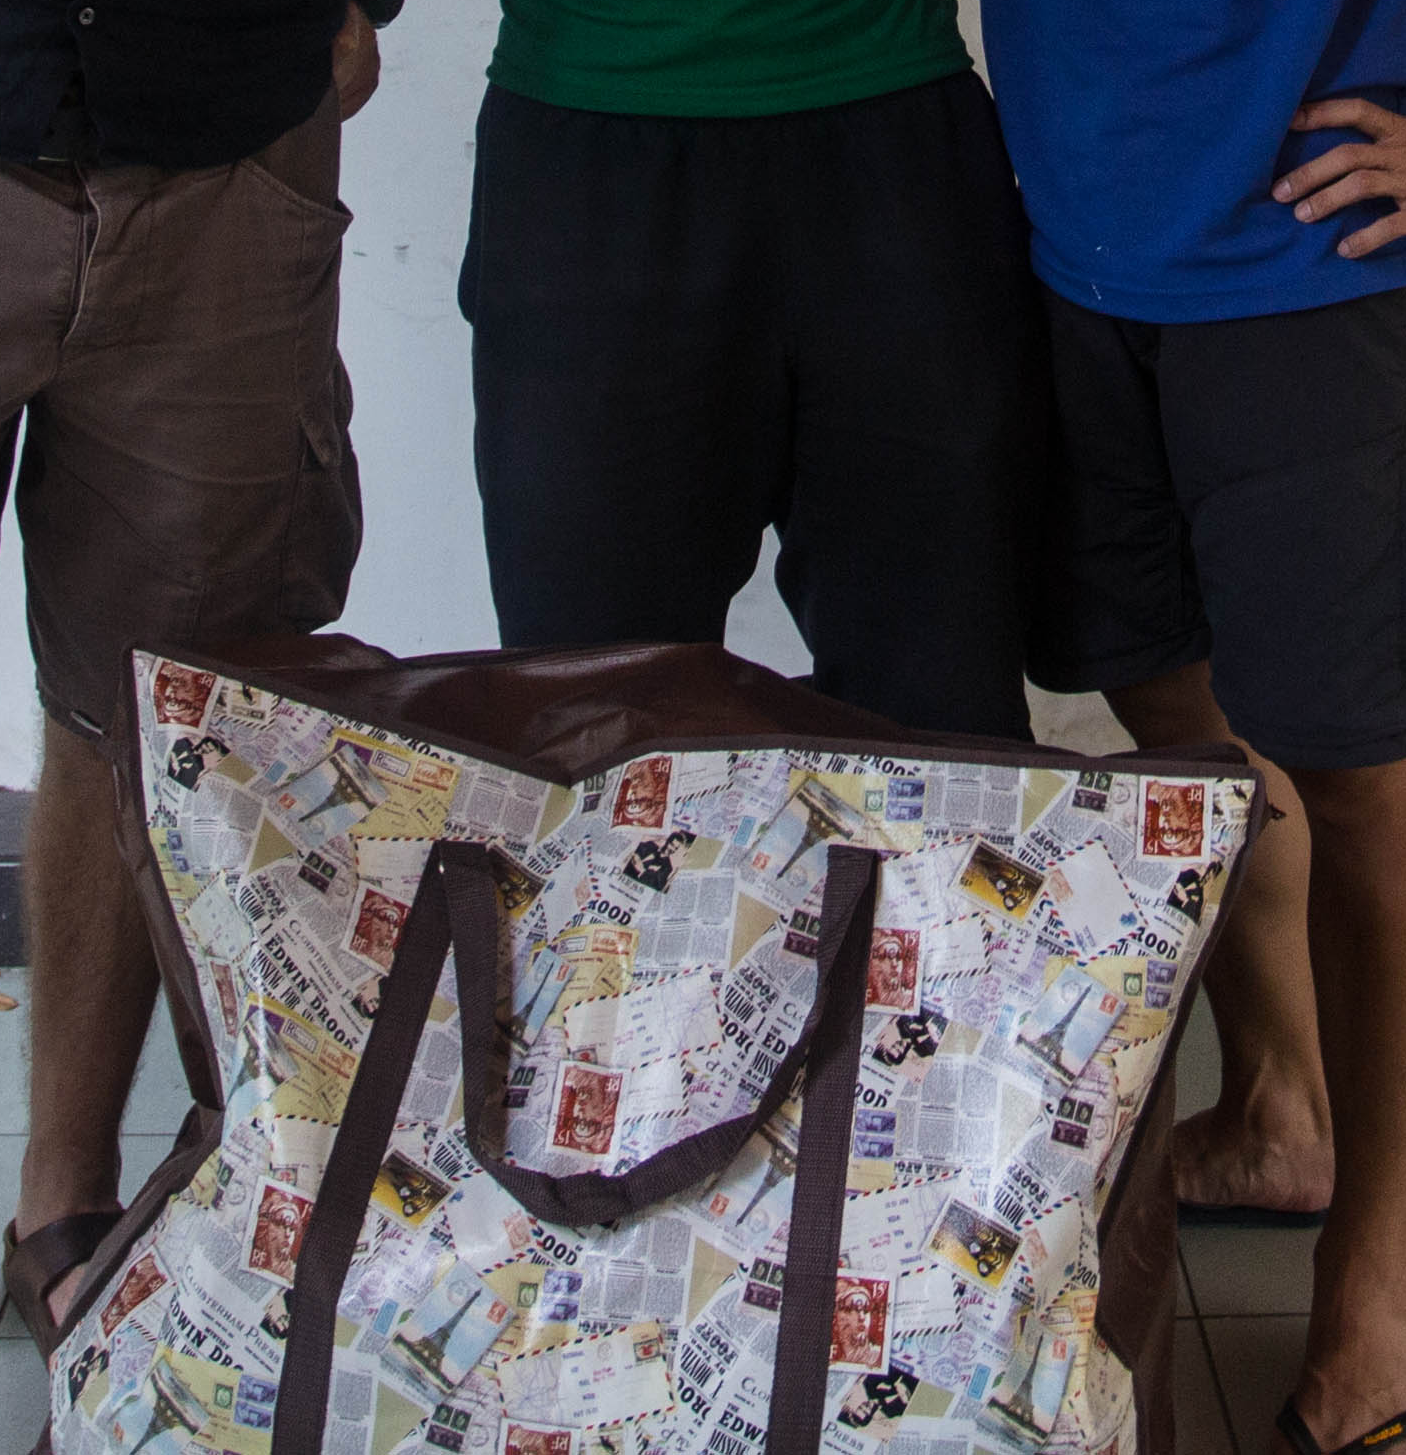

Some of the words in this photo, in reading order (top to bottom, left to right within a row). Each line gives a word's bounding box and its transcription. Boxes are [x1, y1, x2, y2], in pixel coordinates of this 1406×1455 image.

[610, 865, 646, 895] PRESS
[1153, 898, 1188, 929] PRESS
[264, 935, 312, 995] EDWIN
[245, 1324, 281, 1365] PRESS
[823, 1421, 865, 1453] PRESS
